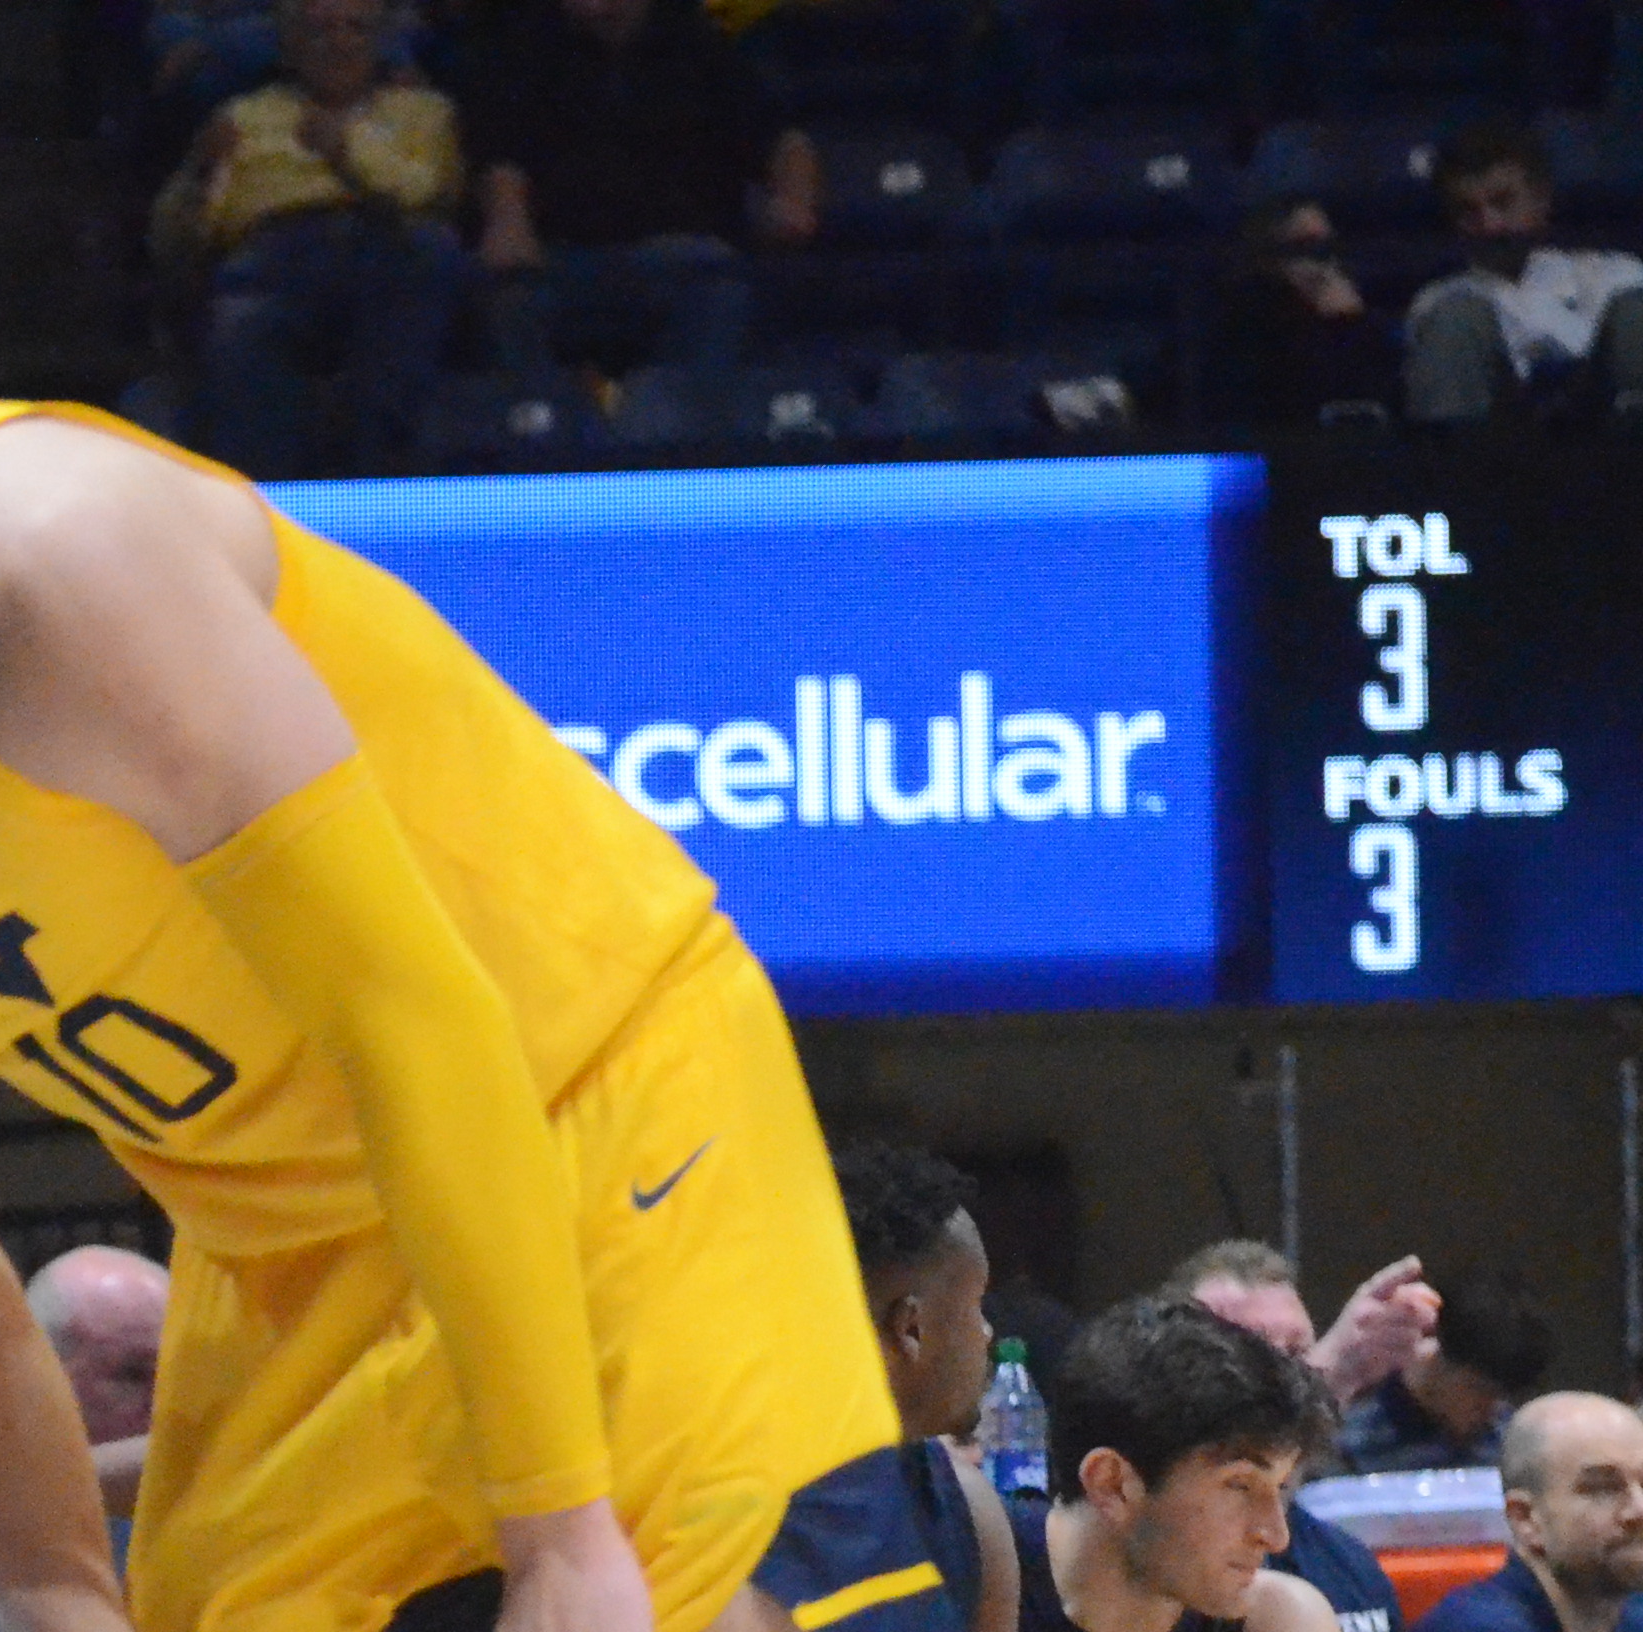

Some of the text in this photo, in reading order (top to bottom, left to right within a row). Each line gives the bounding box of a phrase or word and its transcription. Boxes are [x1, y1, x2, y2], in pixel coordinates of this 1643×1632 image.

[1319, 513, 1472, 578] TOL
[1358, 583, 1428, 731] 3
[1323, 748, 1568, 820] FOULS
[1349, 823, 1420, 973] 3
[14, 993, 239, 1143] 10
